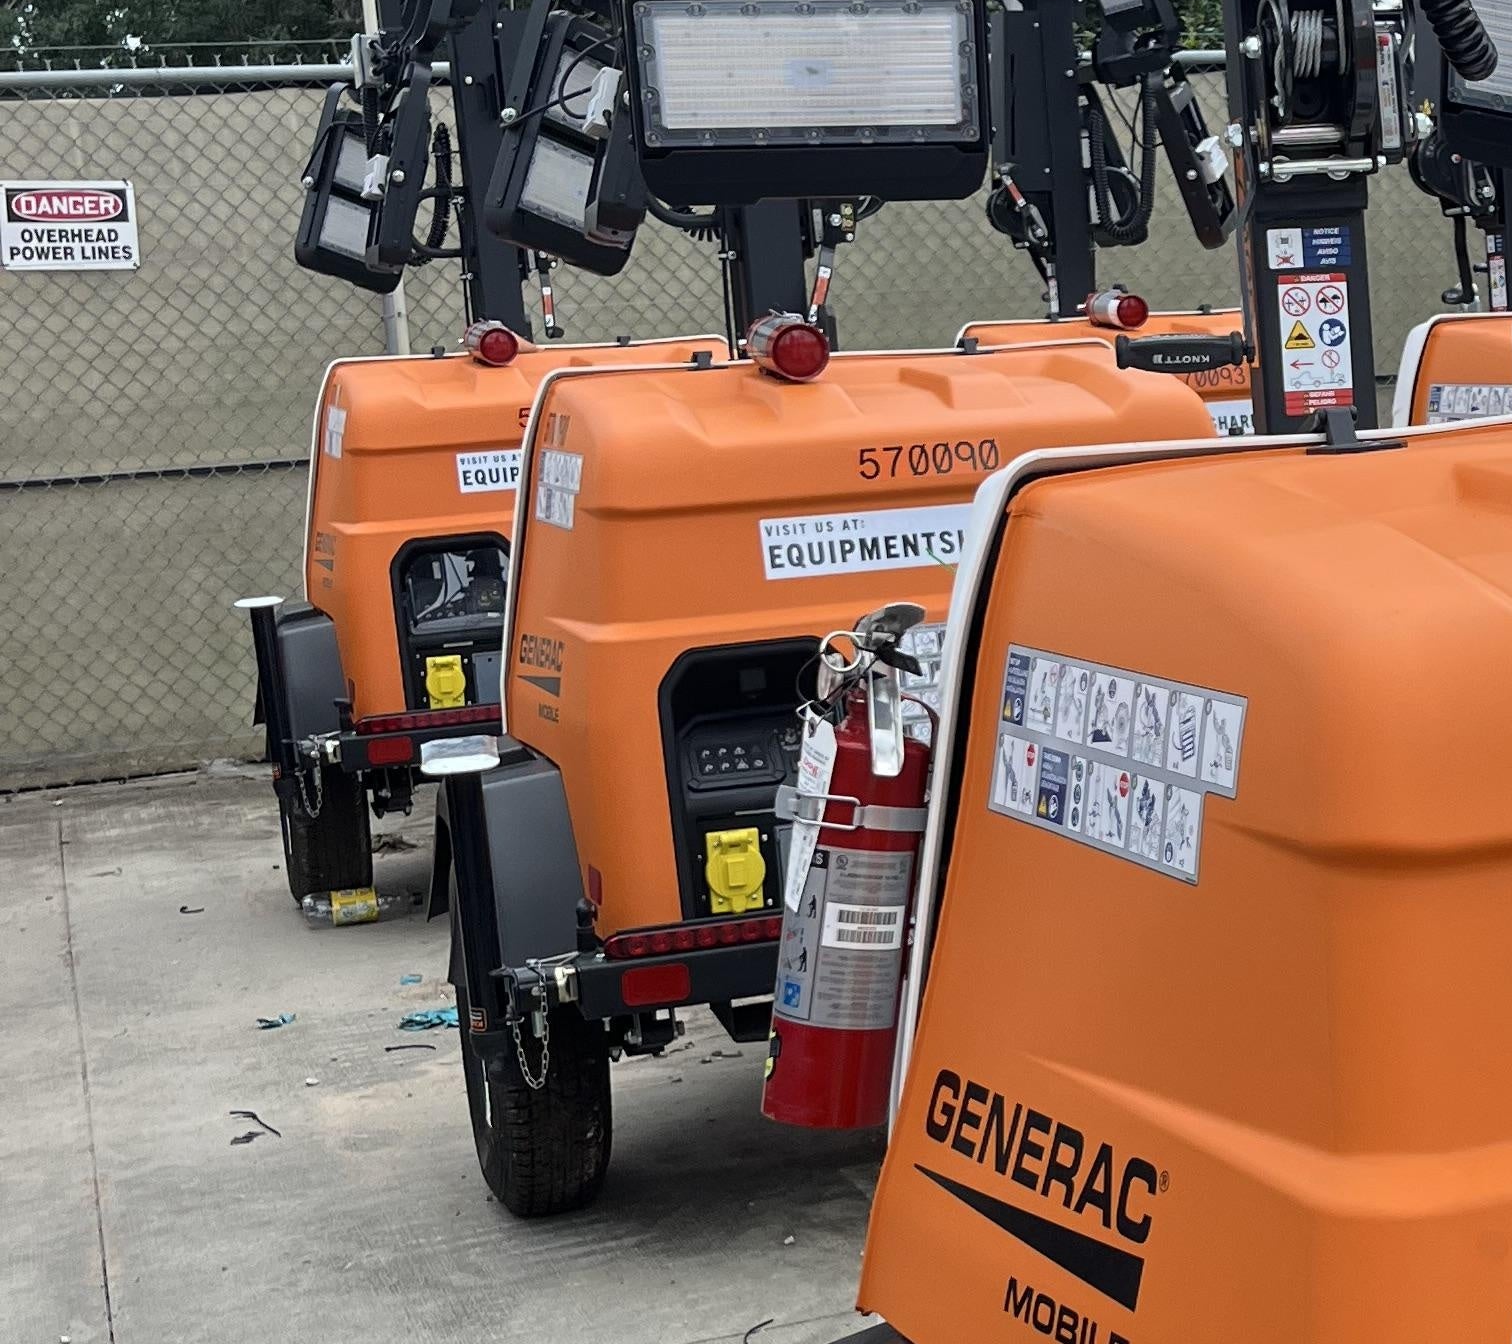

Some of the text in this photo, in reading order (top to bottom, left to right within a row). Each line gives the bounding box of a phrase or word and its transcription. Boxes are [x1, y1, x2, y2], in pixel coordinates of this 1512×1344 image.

[20, 196, 115, 215] DANGER
[21, 229, 119, 243] OVERHEAD
[9, 245, 133, 261] POWER LINES
[1165, 354, 1210, 364] KNOTT
[1213, 414, 1253, 431] HAR
[460, 455, 488, 465] VISIT
[493, 454, 507, 463] US
[859, 439, 999, 480] 570090
[462, 467, 519, 486] EQUIP
[765, 519, 865, 537] VISIT US AT:
[926, 1069, 1157, 1244] GENERAC
